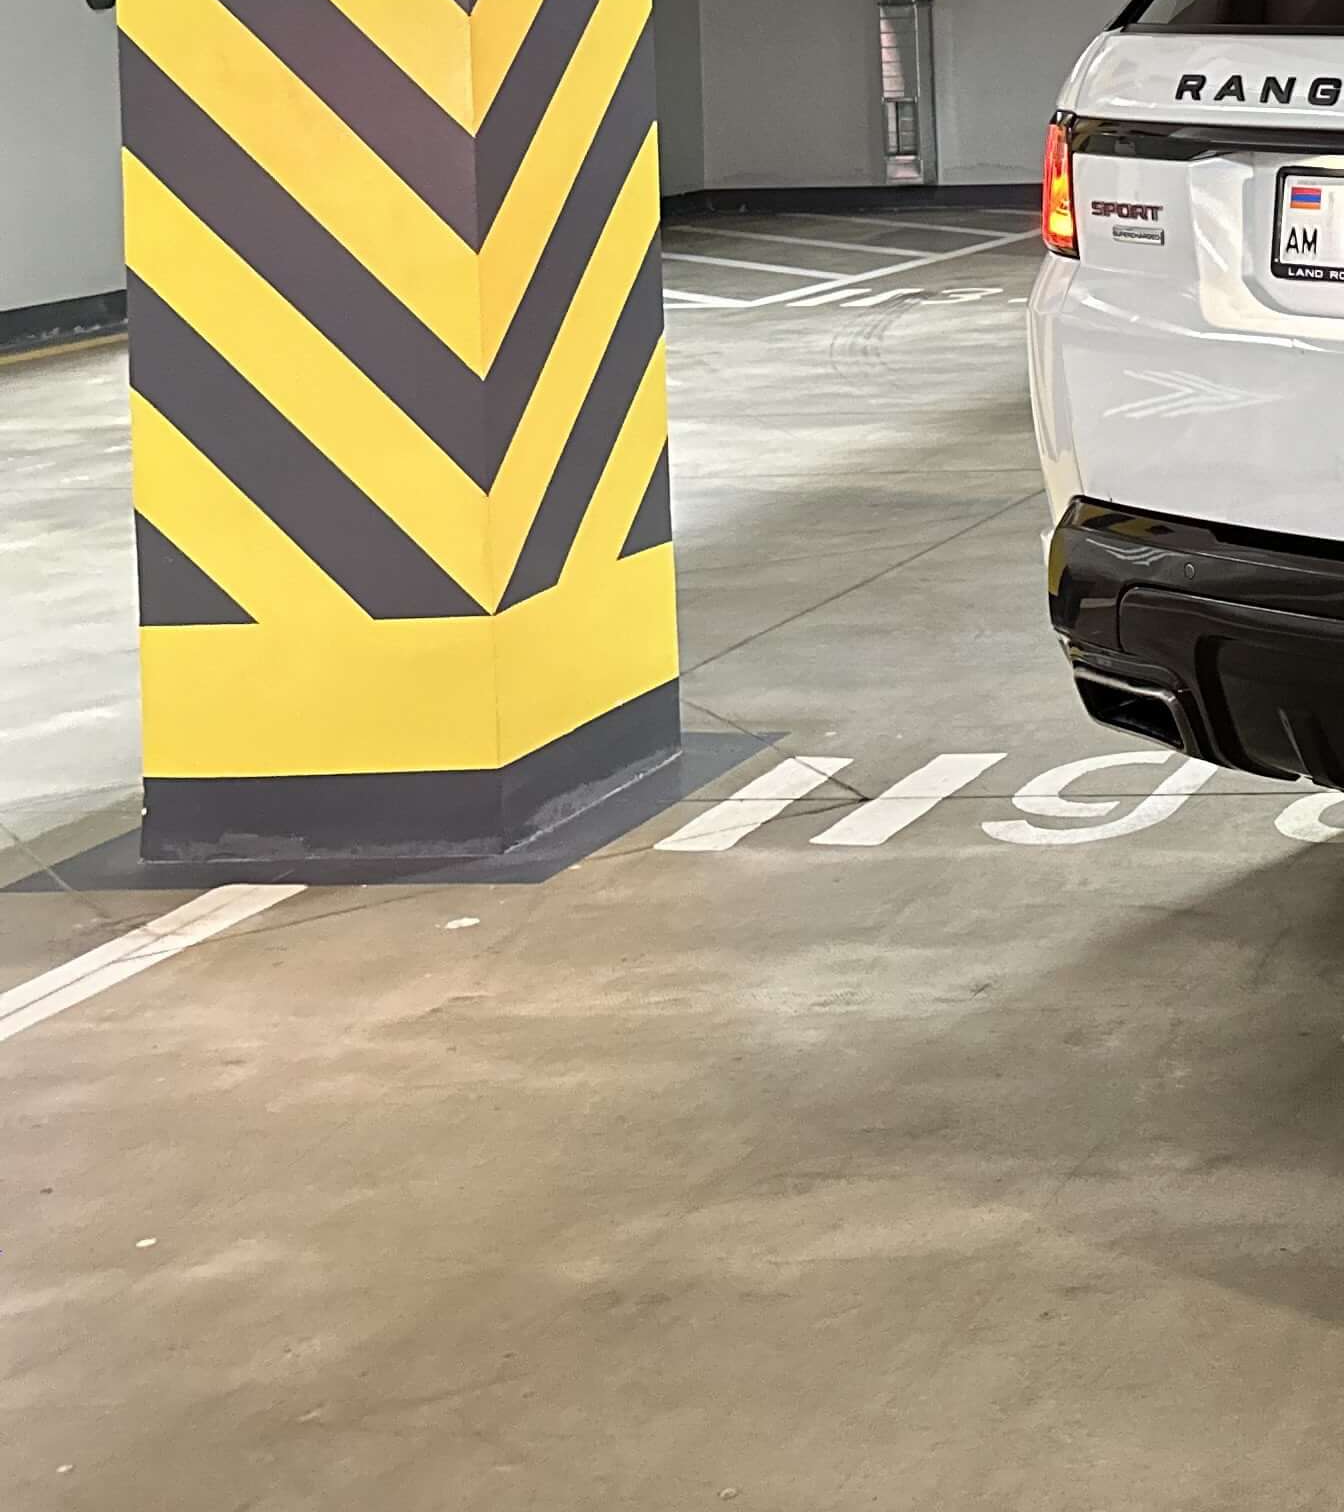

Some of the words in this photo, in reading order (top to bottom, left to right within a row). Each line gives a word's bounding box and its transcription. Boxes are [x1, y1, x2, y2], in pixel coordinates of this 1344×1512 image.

[1091, 199, 1163, 222] SPORT
[1285, 225, 1318, 255] AM
[1287, 267, 1324, 278] LAND
